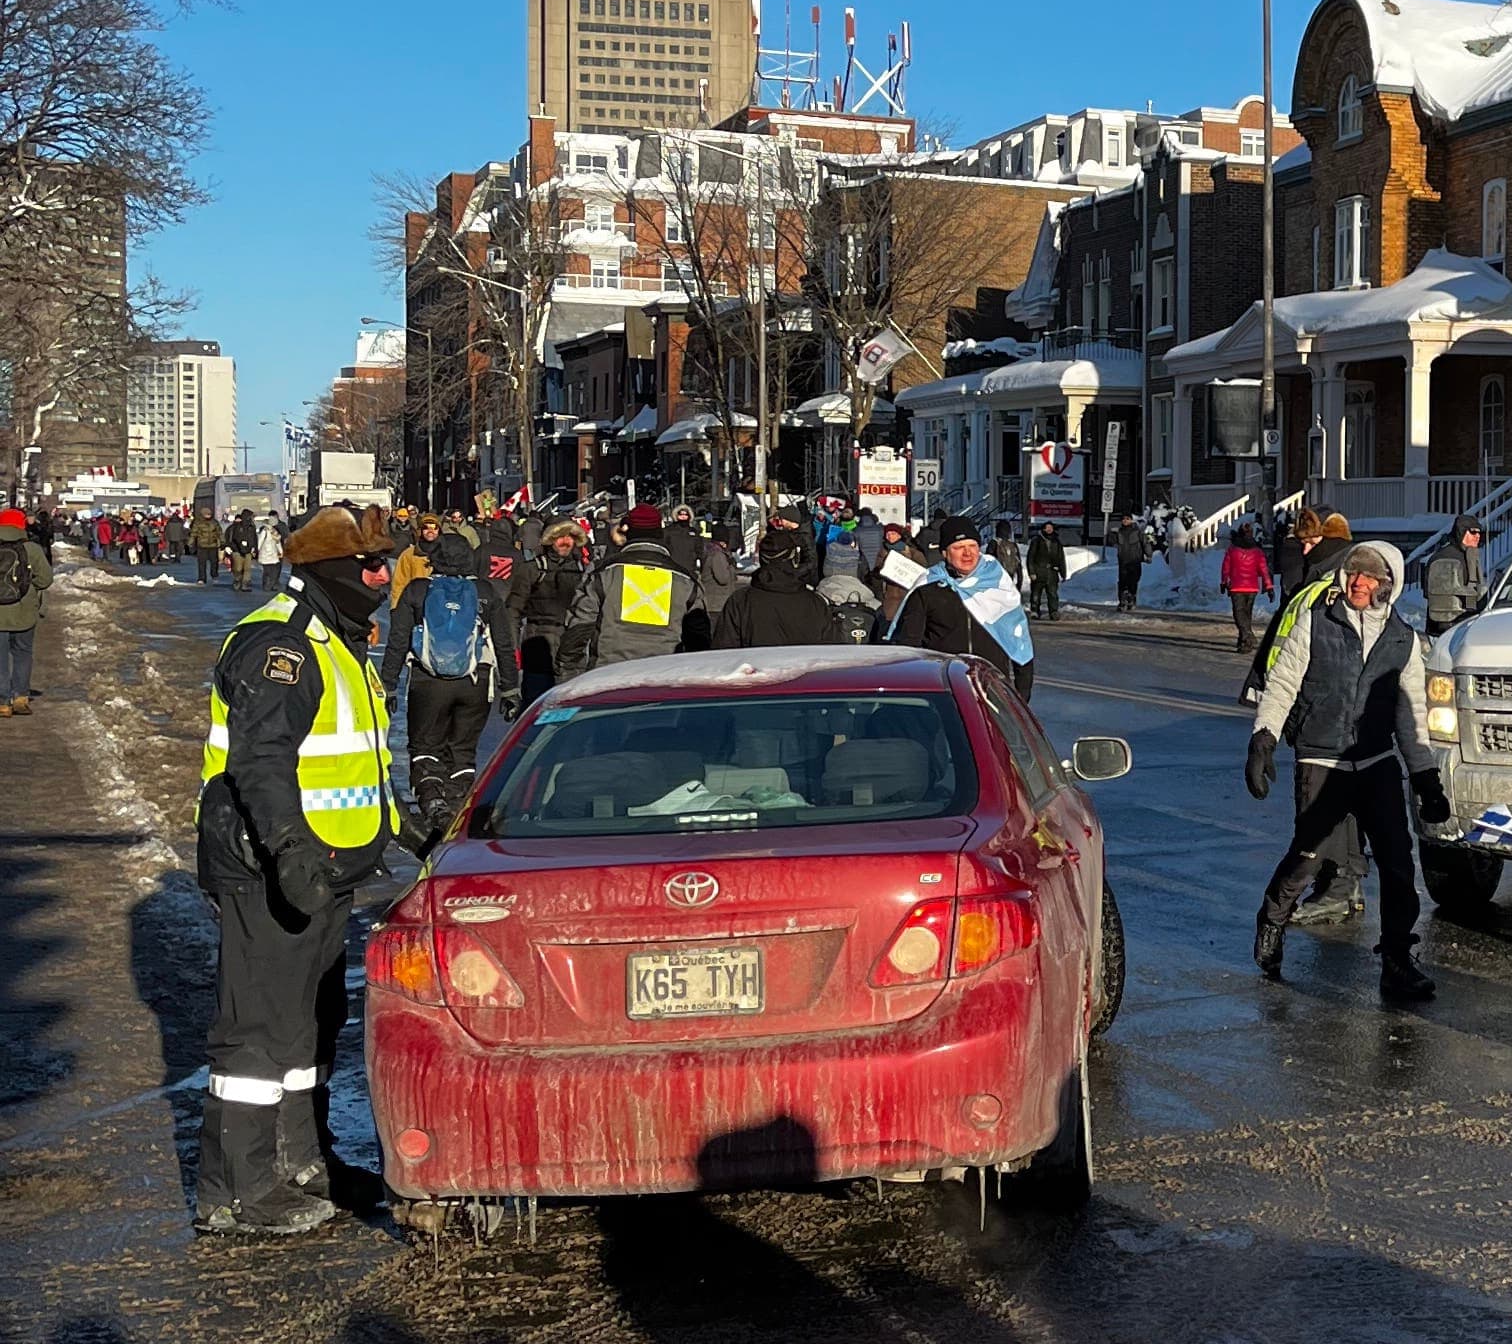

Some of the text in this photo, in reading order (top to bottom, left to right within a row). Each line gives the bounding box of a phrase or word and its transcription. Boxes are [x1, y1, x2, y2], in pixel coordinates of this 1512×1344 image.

[917, 471, 937, 486] 50
[860, 485, 907, 495] HOTEL
[444, 895, 518, 906] COROLLA
[636, 963, 757, 1001] K65 TYH
